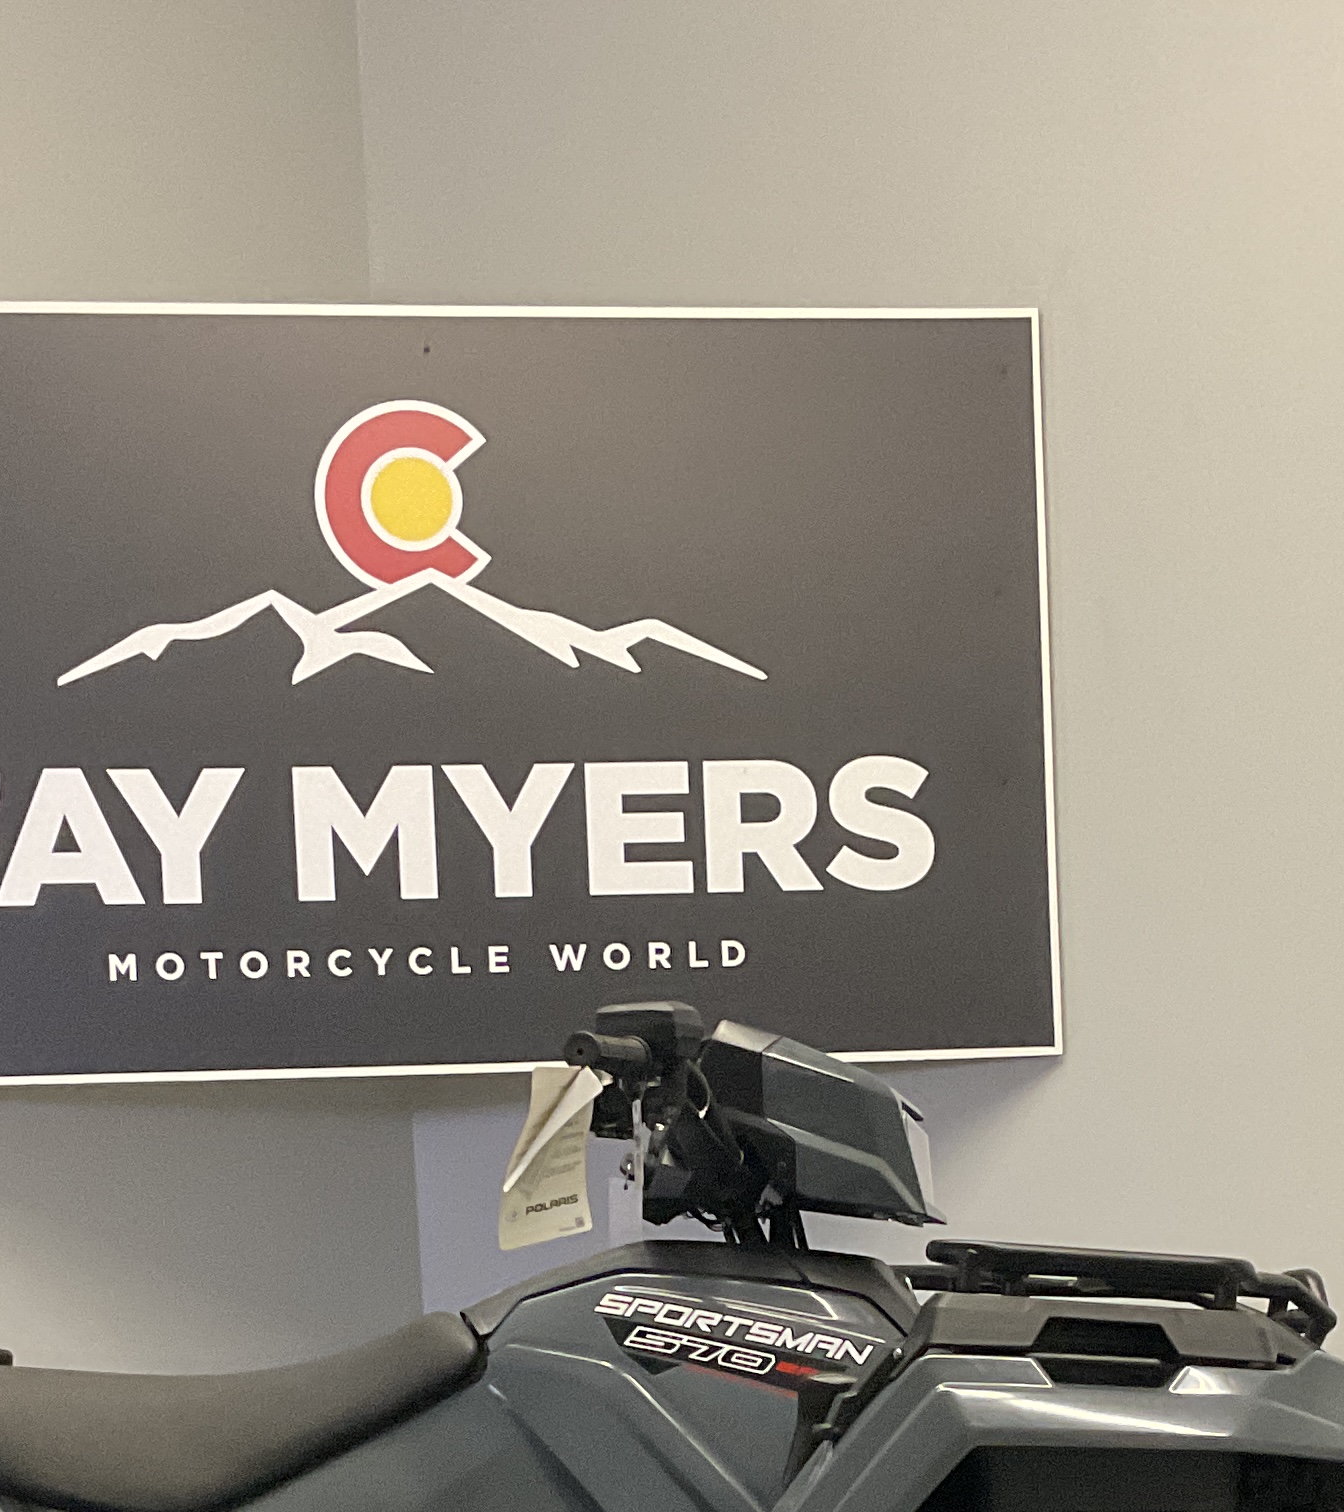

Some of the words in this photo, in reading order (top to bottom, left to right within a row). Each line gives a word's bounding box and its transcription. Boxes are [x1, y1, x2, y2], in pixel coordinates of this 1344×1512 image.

[292, 756, 934, 901] MYERS
[109, 946, 509, 981] MOTORCYCLE
[549, 940, 745, 971] WORLD
[524, 1192, 580, 1216] POLARIS
[594, 1293, 874, 1365] SPORTSMAN
